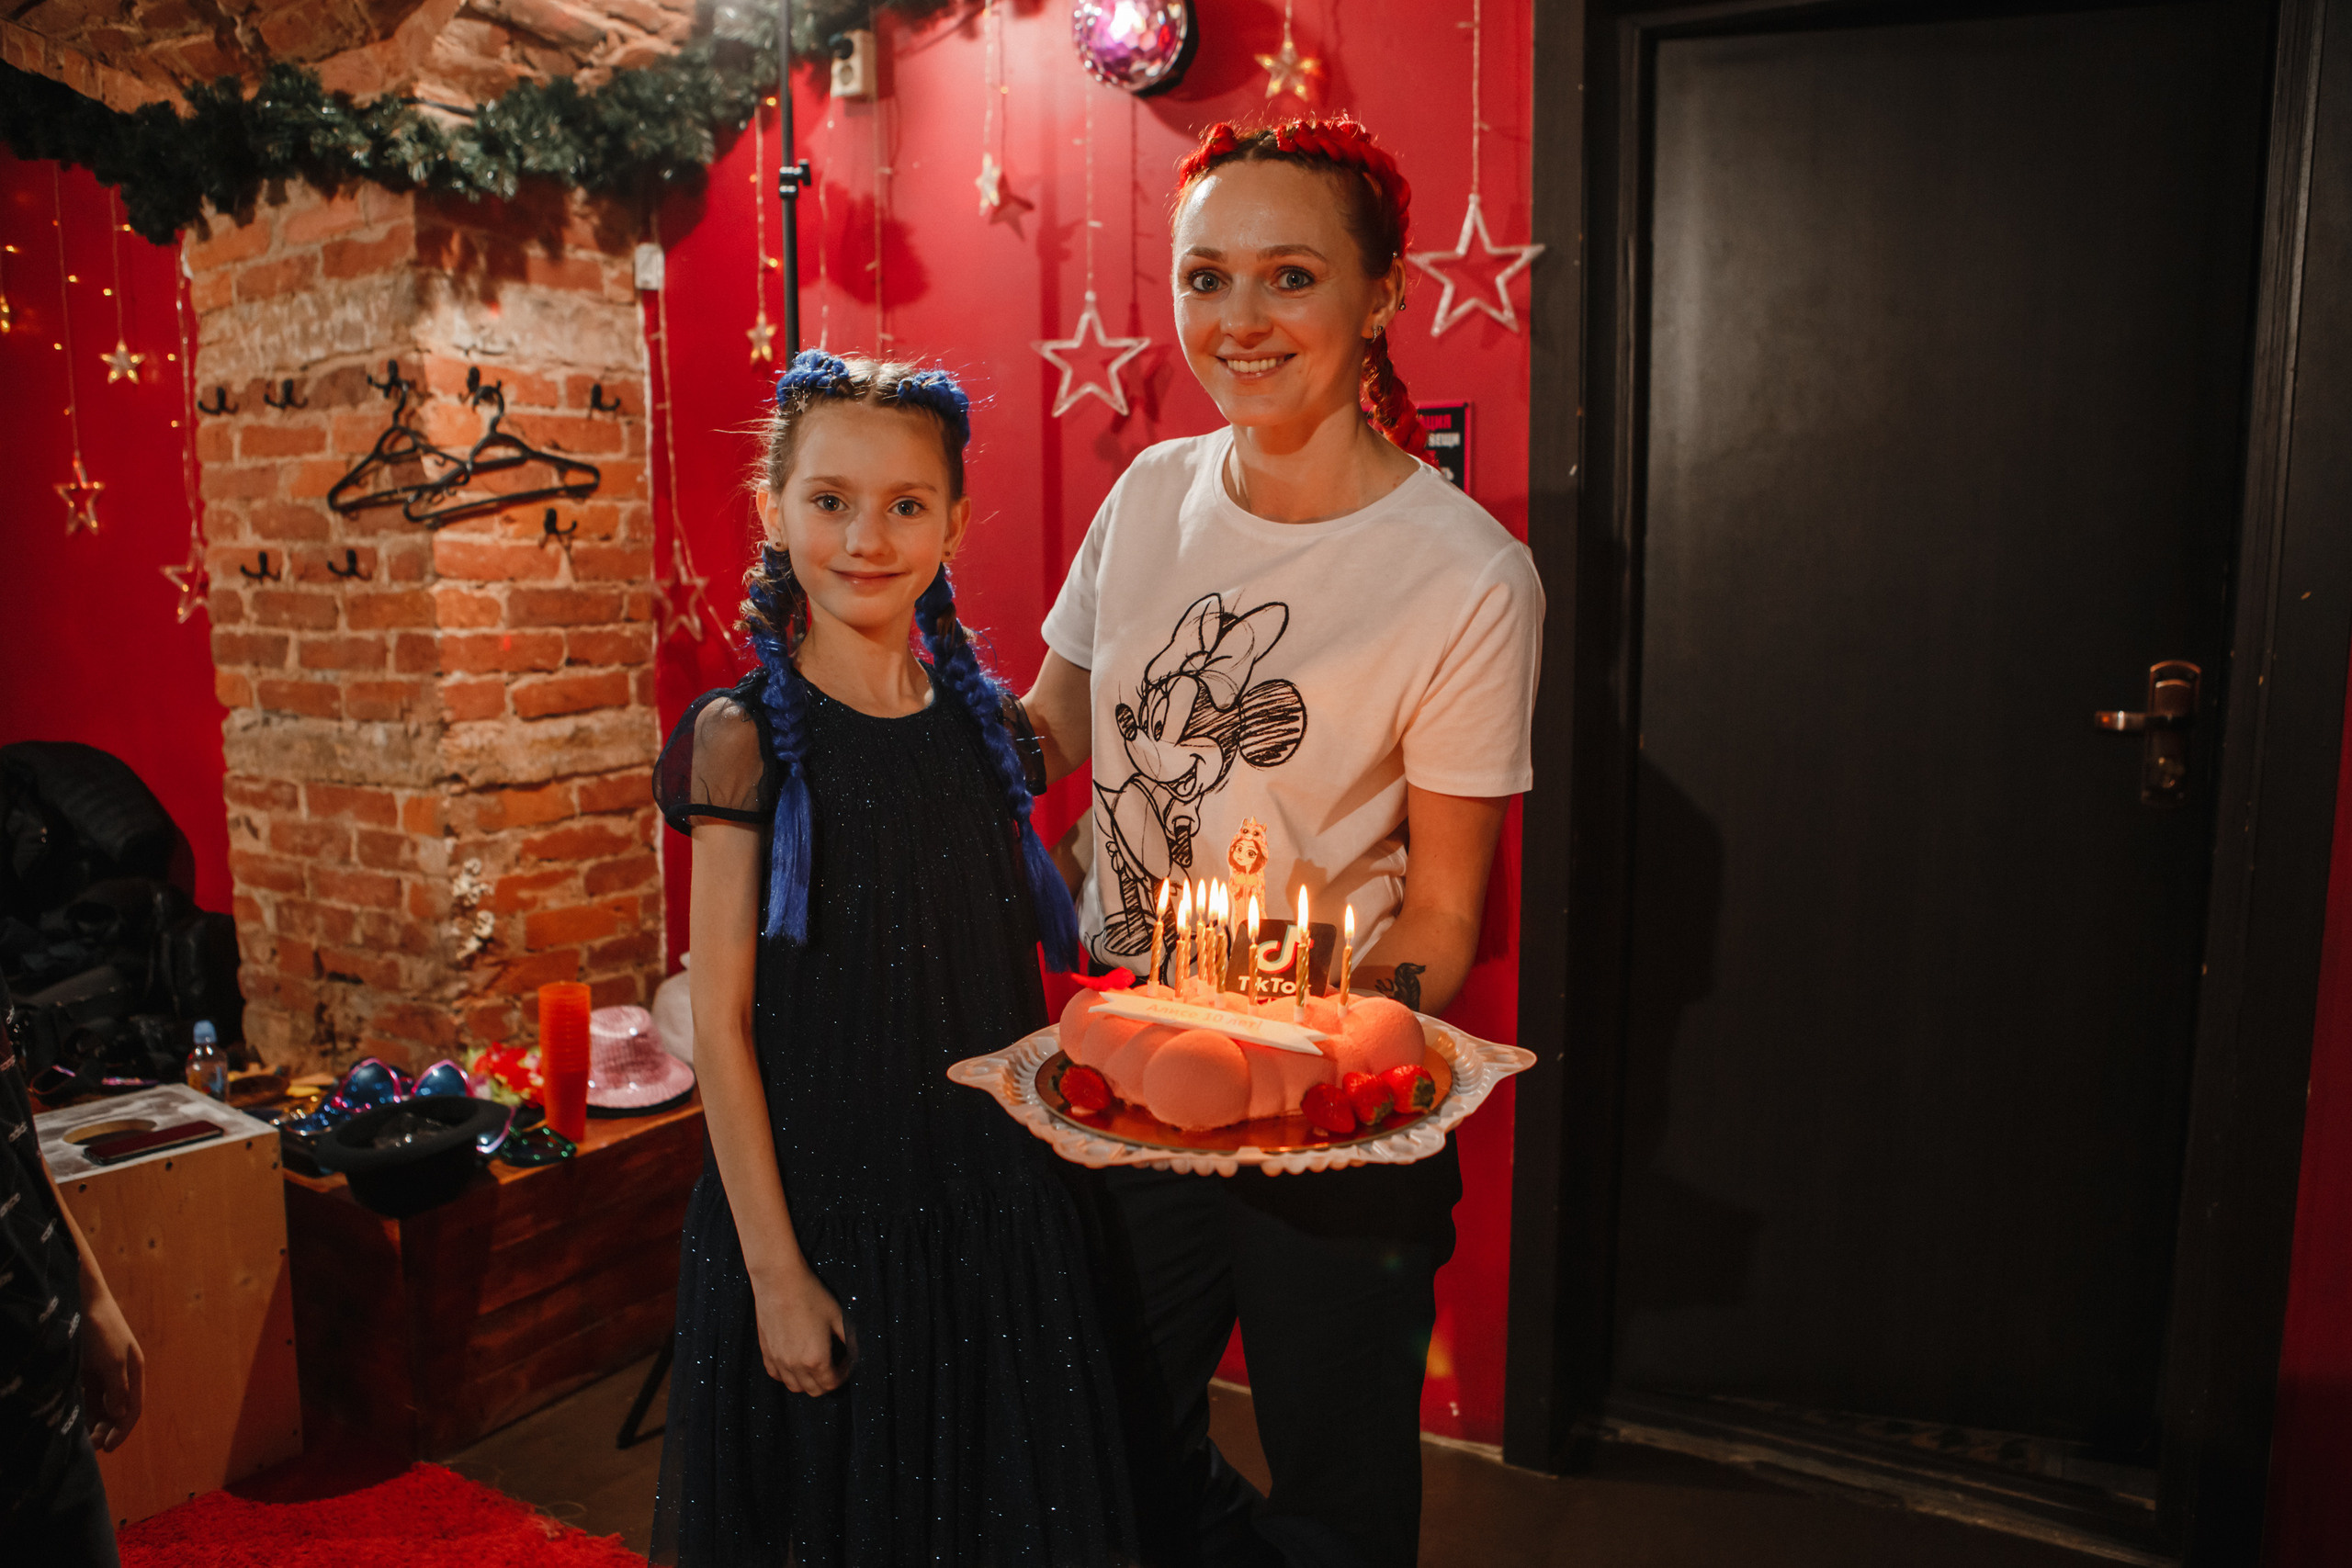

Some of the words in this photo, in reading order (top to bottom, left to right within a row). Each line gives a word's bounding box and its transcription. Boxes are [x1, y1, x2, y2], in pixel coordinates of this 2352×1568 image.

[1238, 976, 1311, 995] TkTo
[1146, 1004, 1198, 1018] Алисе
[1203, 1012, 1224, 1021] 10
